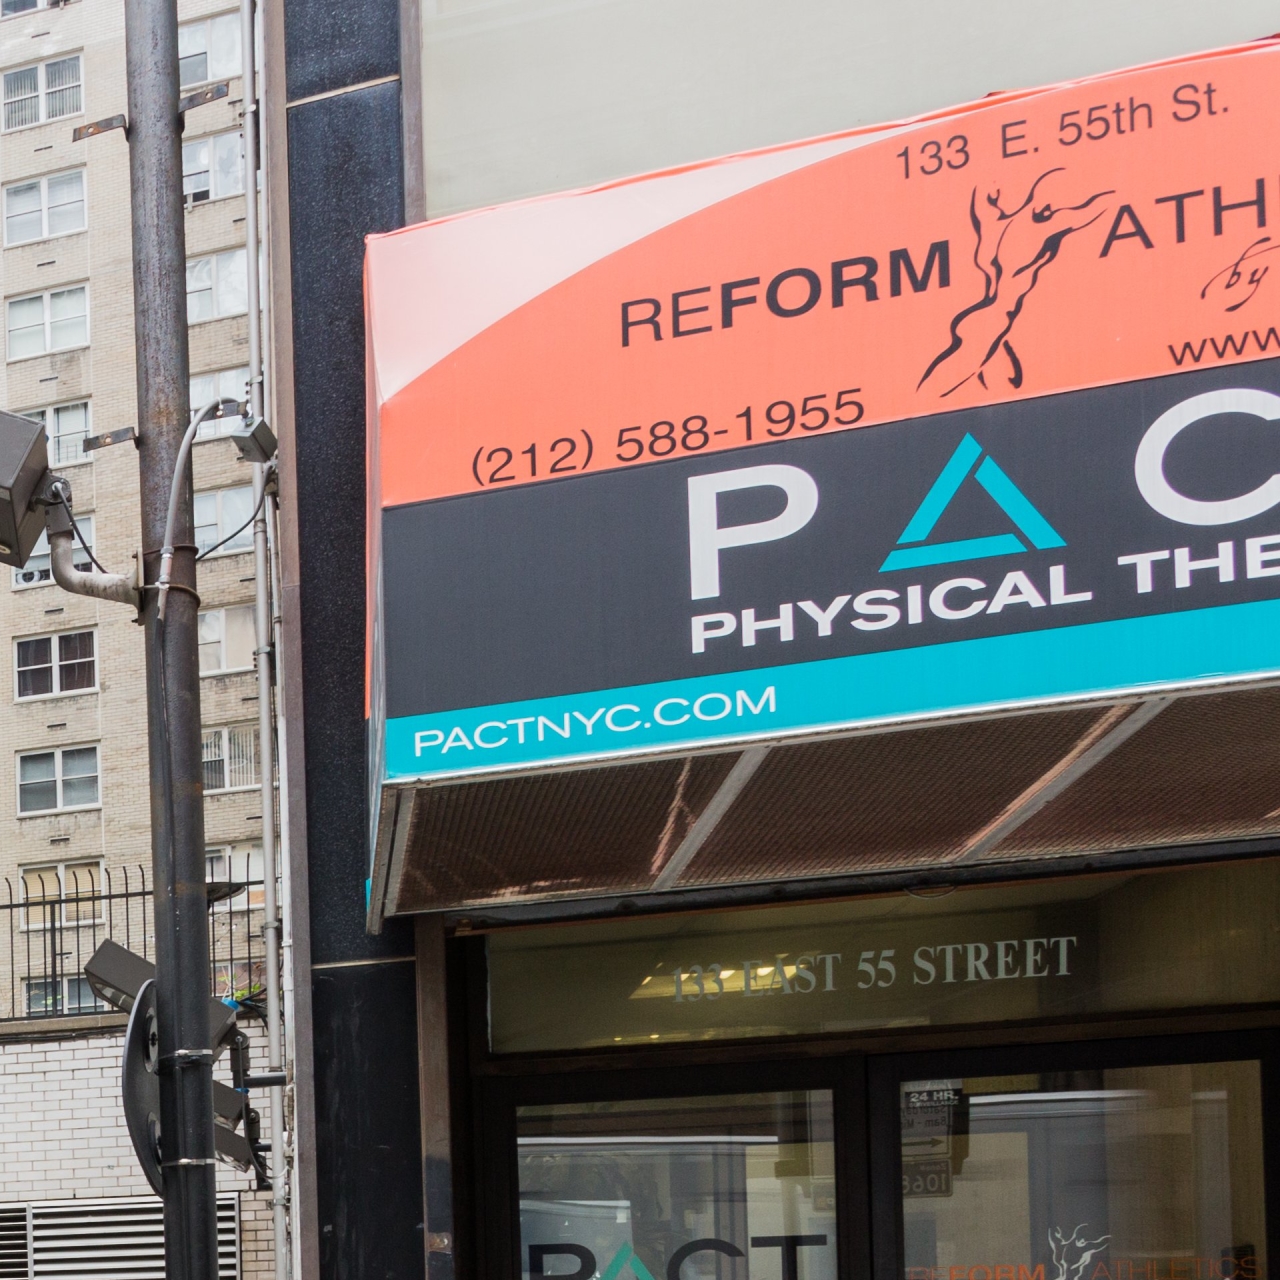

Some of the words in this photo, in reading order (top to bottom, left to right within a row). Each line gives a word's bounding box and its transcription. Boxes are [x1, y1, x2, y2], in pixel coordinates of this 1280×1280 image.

[895, 135, 971, 181] 133
[1000, 119, 1040, 160] E.
[1058, 96, 1153, 148] 55th
[1172, 82, 1230, 123] St.
[621, 239, 952, 347] REFORM
[1098, 174, 1280, 259] ATH
[471, 428, 595, 487] (212)
[615, 388, 866, 464] 588-1955
[691, 564, 1093, 654] PHYSICAL
[414, 685, 777, 758] PACTNYC.COM
[671, 963, 725, 1004] 133
[741, 953, 842, 998] EAST
[857, 948, 897, 989] 55
[913, 936, 1078, 986] STREET
[909, 1092, 929, 1102] 24
[933, 1090, 959, 1100] HR.
